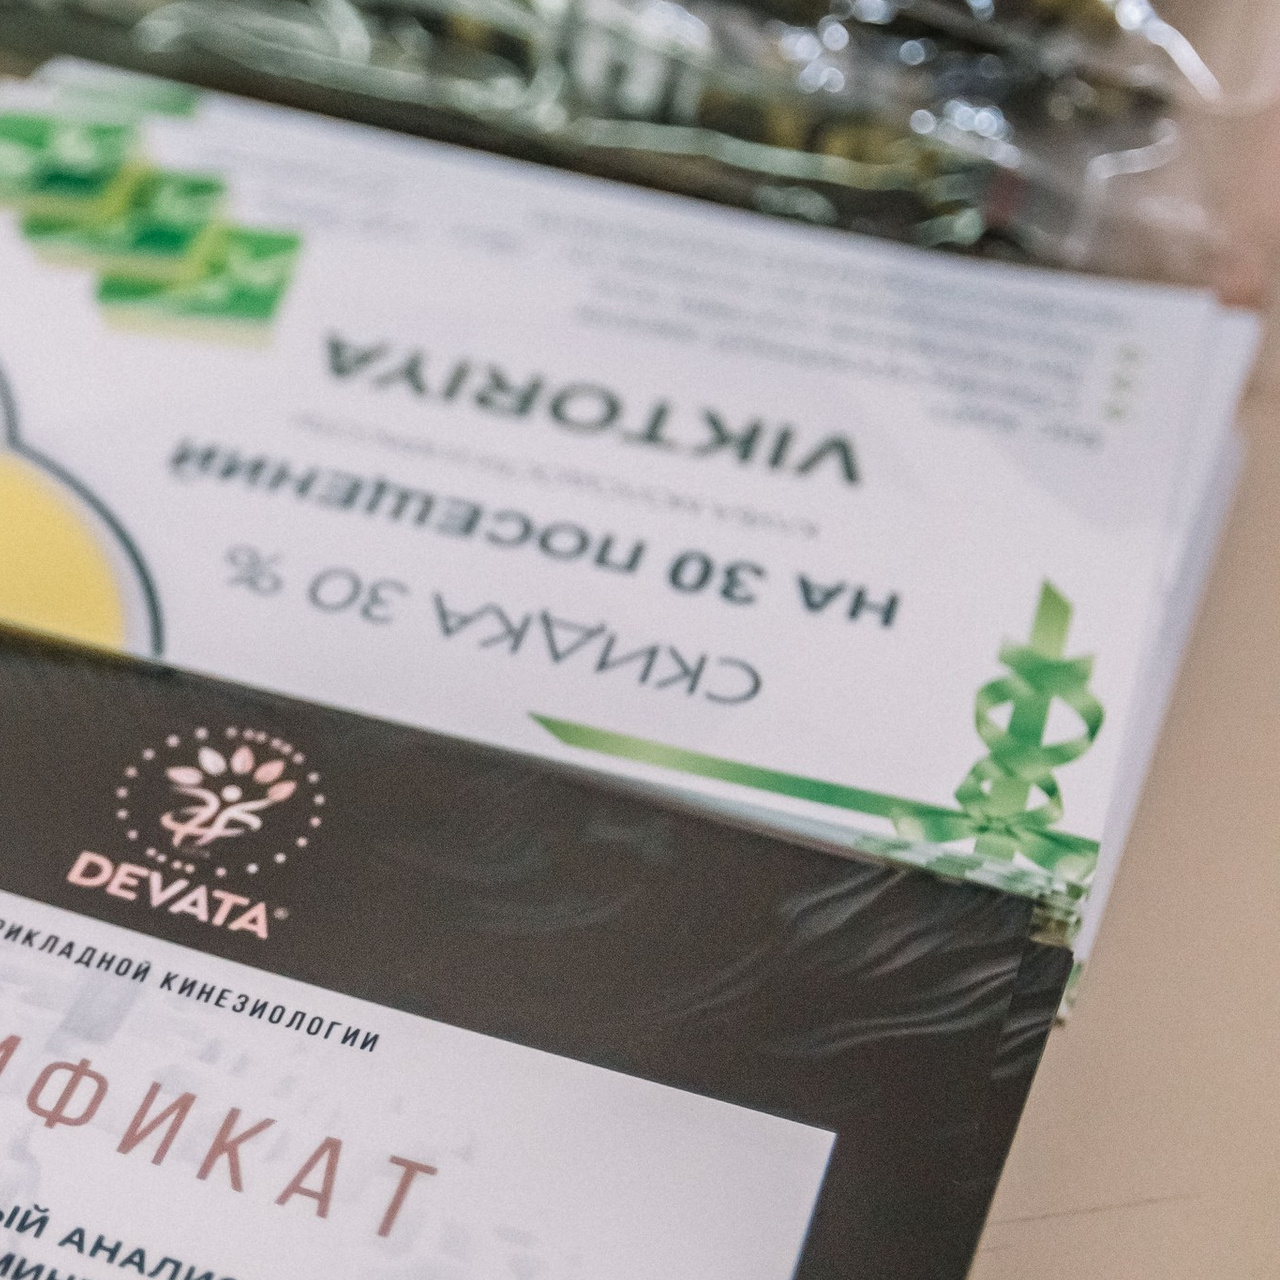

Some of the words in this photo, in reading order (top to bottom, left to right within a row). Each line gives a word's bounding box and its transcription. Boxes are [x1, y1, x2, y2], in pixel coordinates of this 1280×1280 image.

[326, 329, 862, 486] VIKTORIYA
[169, 436, 646, 576] ПОСЕЩЕНИЙ
[224, 544, 284, 596] %
[308, 566, 411, 625] 30
[668, 550, 766, 606] 30
[796, 572, 900, 629] НА
[433, 592, 762, 705] СКИДКА
[67, 851, 270, 939] DEVATA
[160, 970, 380, 1053] КИНЕЗИОЛОГИИ
